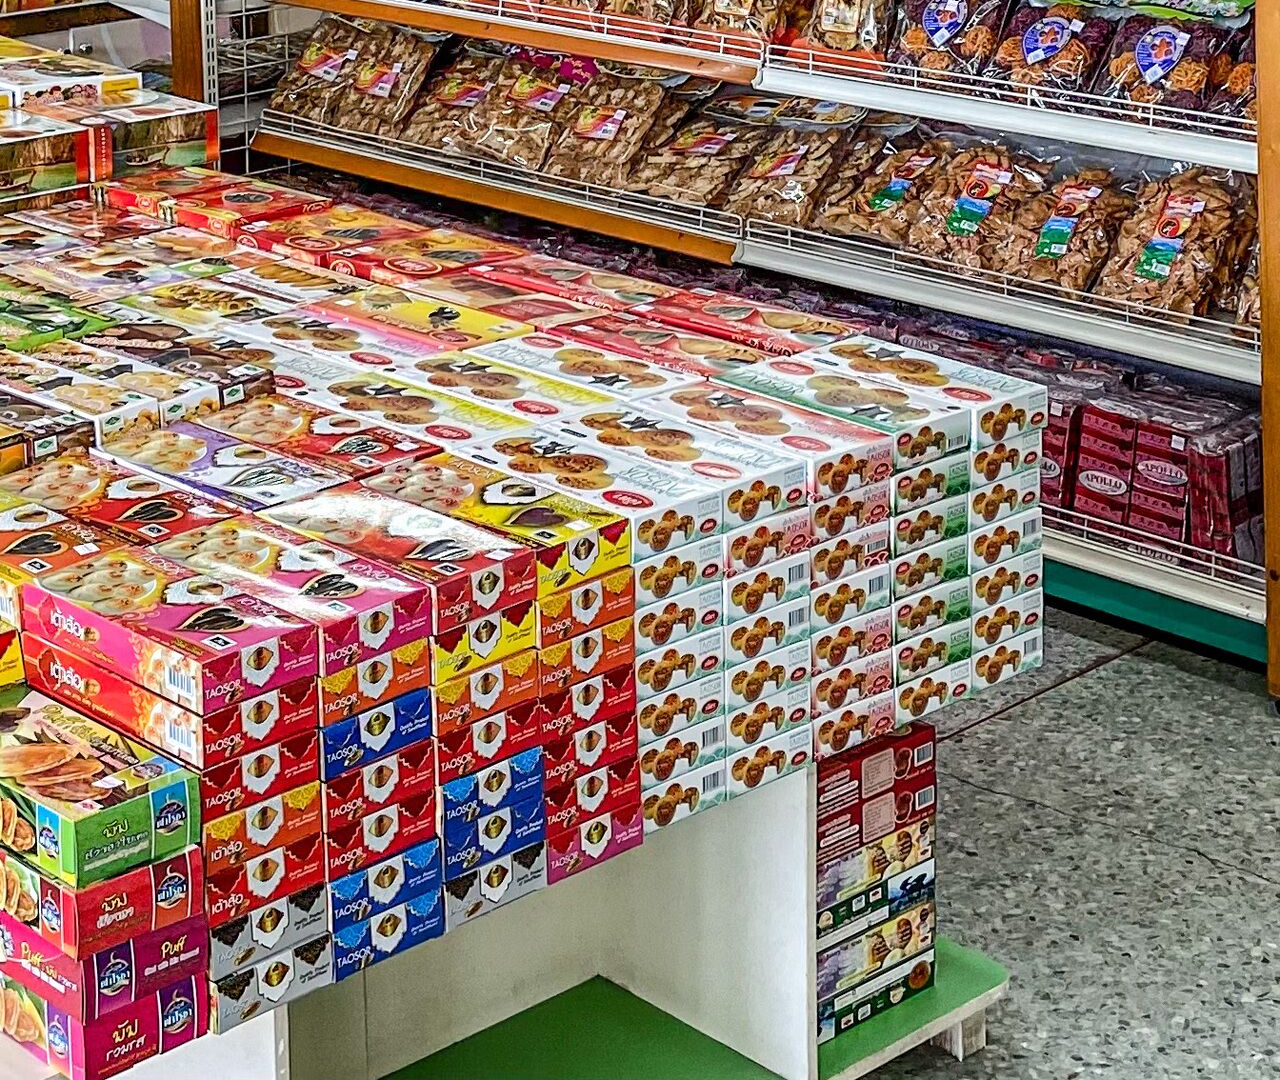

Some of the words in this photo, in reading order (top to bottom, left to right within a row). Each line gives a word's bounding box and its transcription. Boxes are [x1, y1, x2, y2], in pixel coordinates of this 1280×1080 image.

[1143, 461, 1183, 479] APOLLO
[1085, 473, 1123, 490] APOLLO
[440, 602, 469, 618] TAOSOR
[542, 619, 571, 635] TAOSOR
[326, 643, 358, 662] TAOSOR
[542, 667, 571, 684] TAOSOR
[206, 680, 241, 699] TAOSOR
[325, 695, 357, 714] TAOSOR
[439, 704, 470, 722] TAOSOR
[543, 715, 571, 731] TAOSOR
[206, 734, 241, 753] TAOSOR
[327, 744, 358, 763] TAOSOR
[441, 752, 472, 769] TAOSOR
[547, 761, 576, 778] TAOSOR
[205, 788, 241, 808] TAOSOR
[330, 798, 363, 818] TAOSOR
[447, 801, 477, 819] TAOSOR
[548, 806, 577, 824] TAOSOR
[330, 848, 363, 868] TAOSOR
[448, 847, 476, 865] TAOSOR
[552, 852, 579, 868] TAOSOR
[334, 898, 368, 919] TAOSOR
[21, 942, 43, 966] Puff
[161, 935, 187, 958] Puff
[338, 947, 371, 966] TAOSOR
